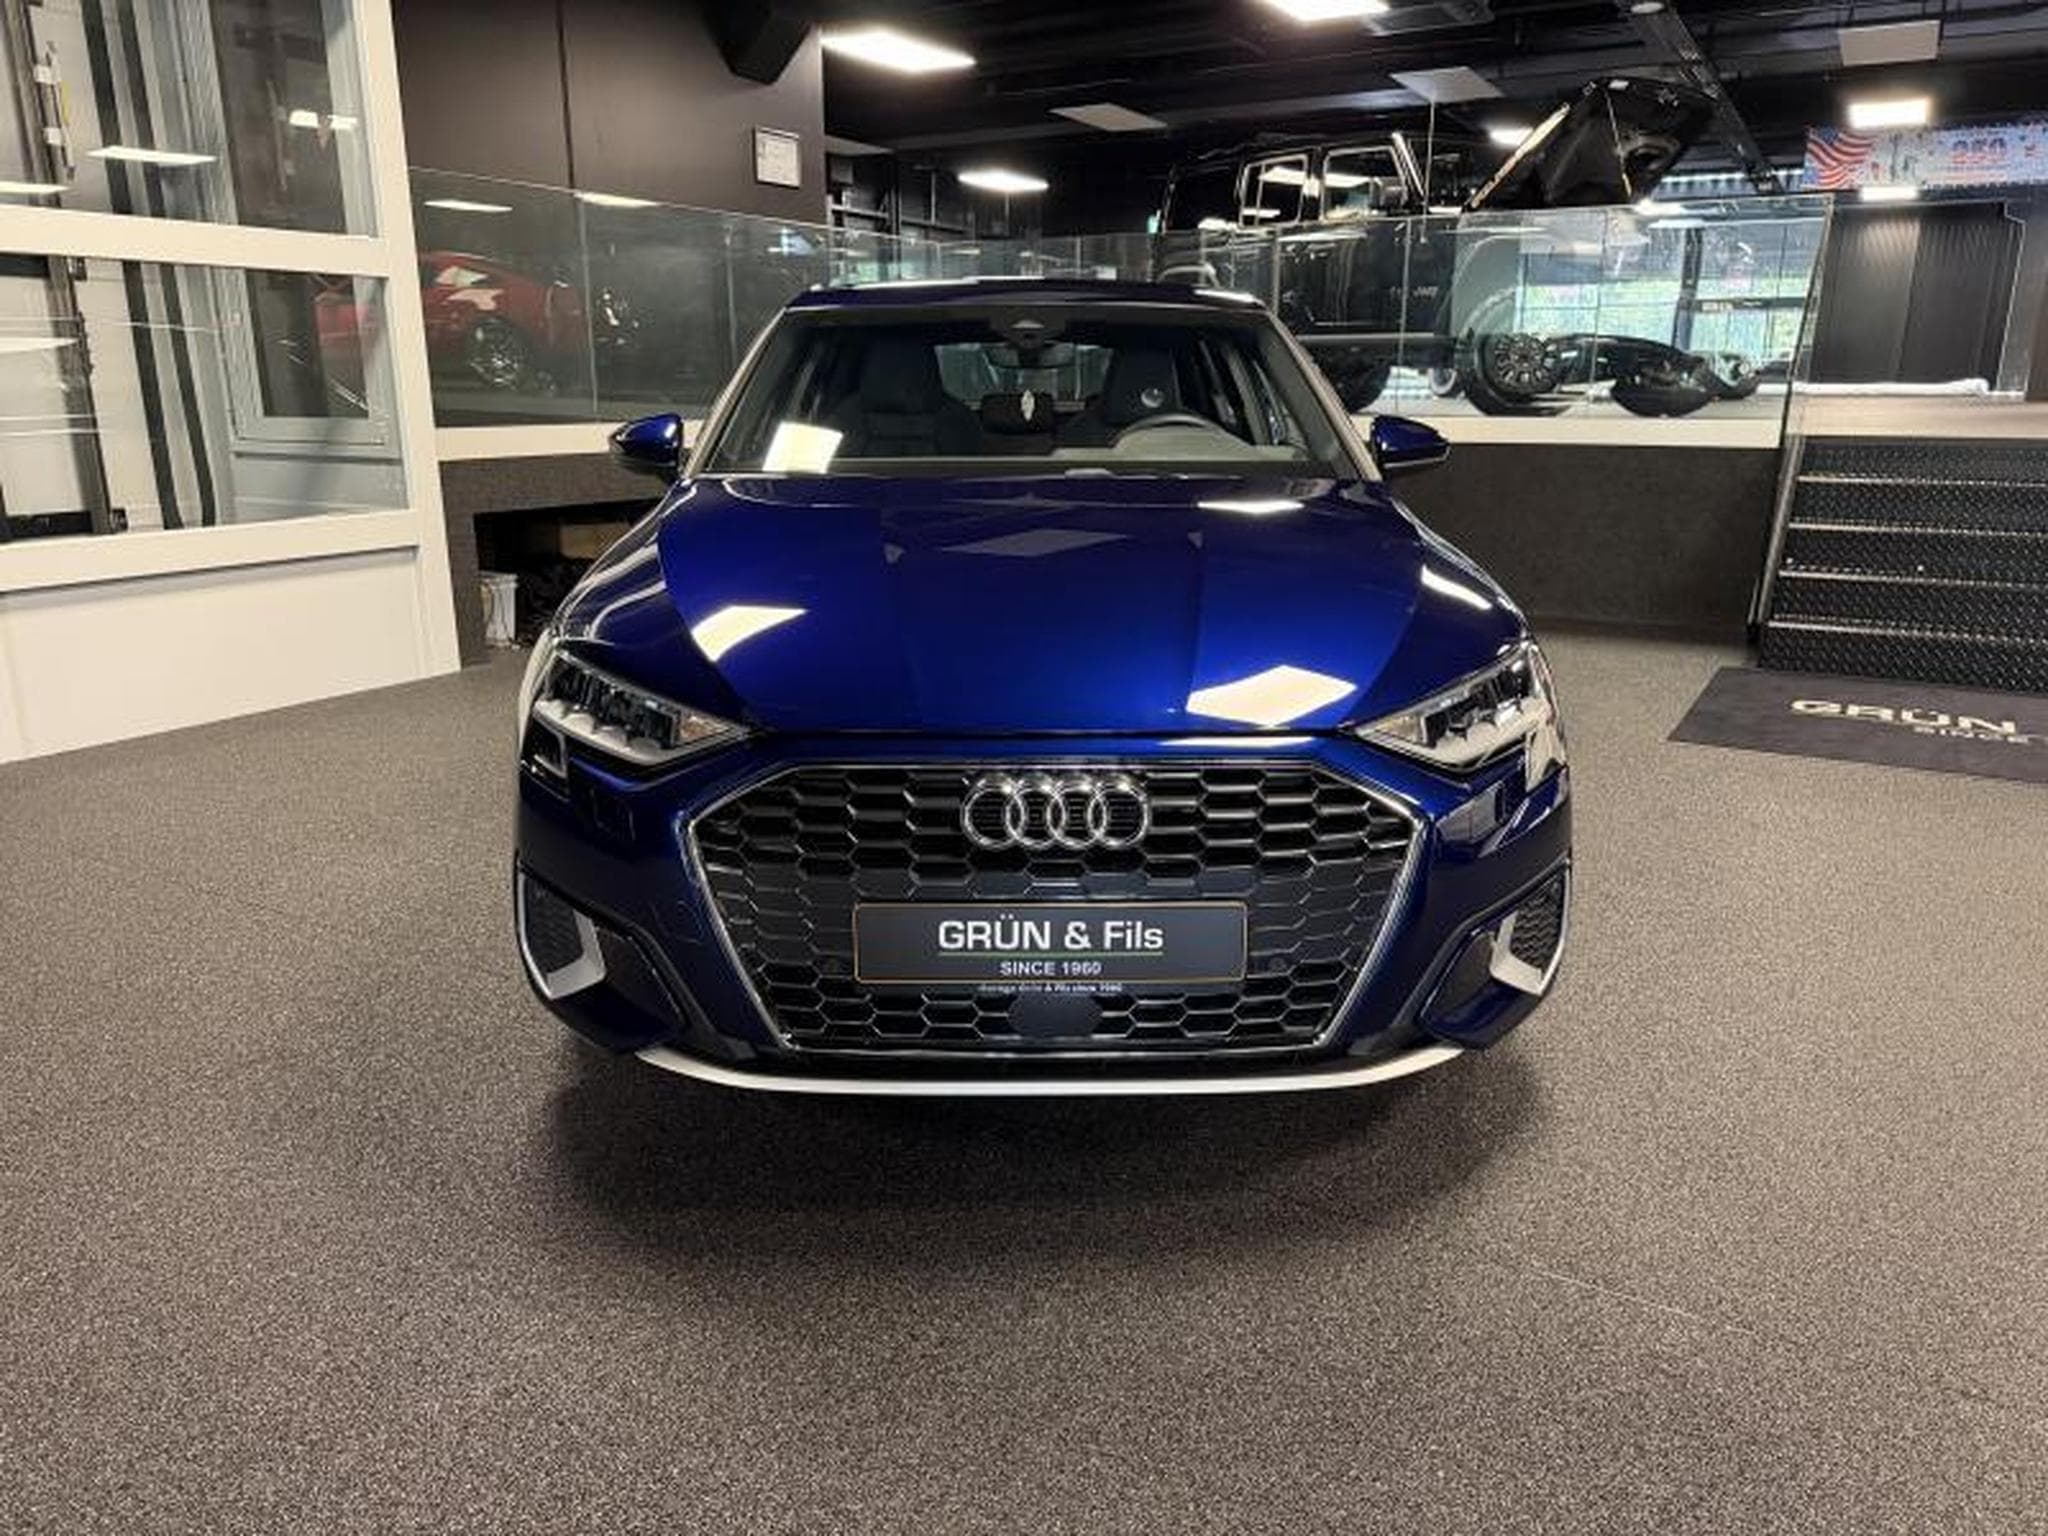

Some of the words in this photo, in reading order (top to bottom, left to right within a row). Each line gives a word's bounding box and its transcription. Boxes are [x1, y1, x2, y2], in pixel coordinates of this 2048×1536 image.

[1791, 700, 2018, 735] GRÜN
[937, 913, 1051, 950] GRÜN
[1063, 920, 1092, 950] &
[1103, 920, 1164, 950] Fils
[999, 960, 1056, 977] SINCE
